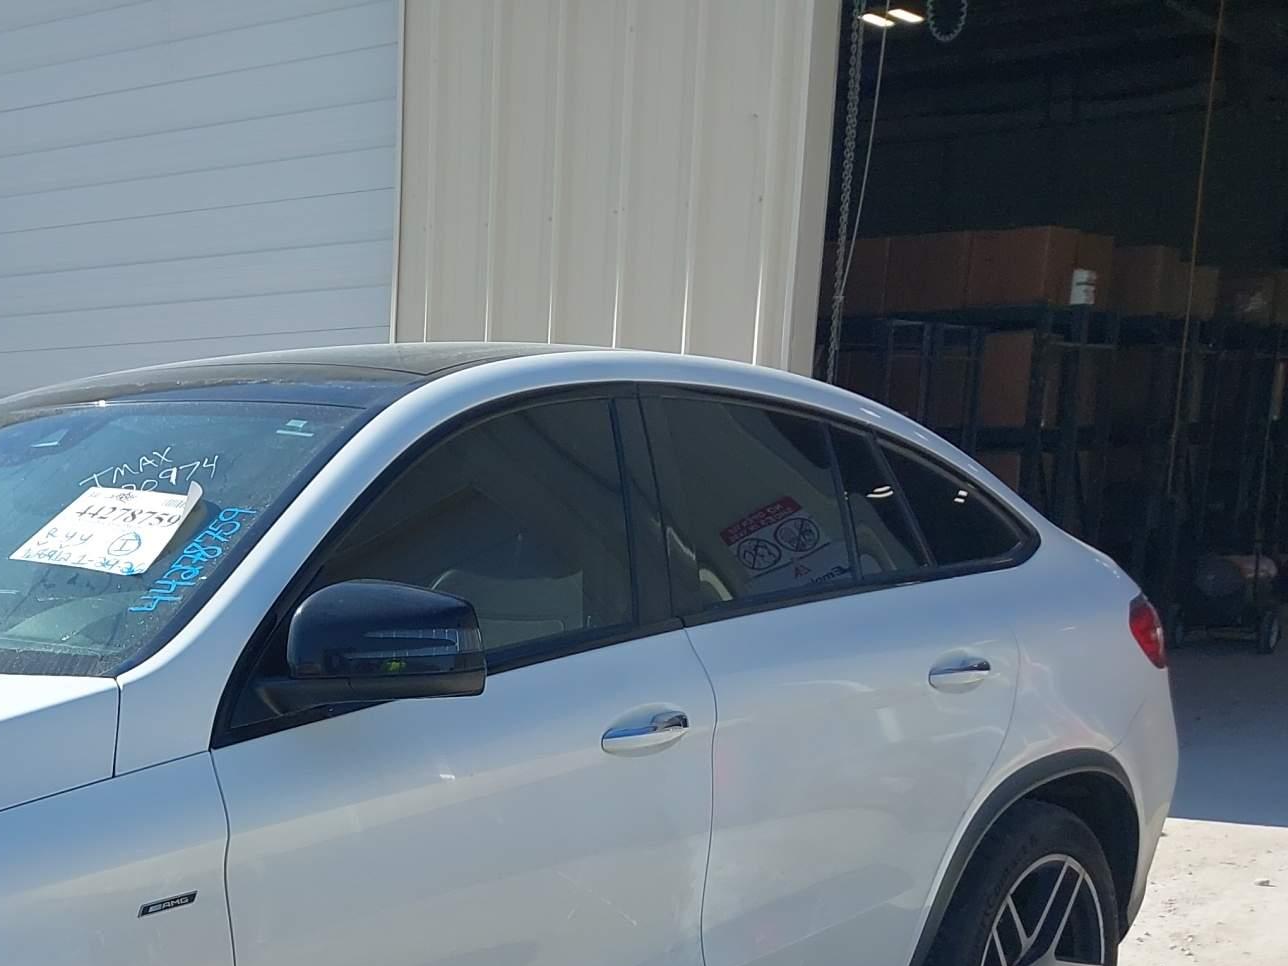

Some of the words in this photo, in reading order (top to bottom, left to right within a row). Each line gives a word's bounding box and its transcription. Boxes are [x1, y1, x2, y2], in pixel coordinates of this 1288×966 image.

[75, 504, 182, 528] 44278759
[128, 508, 257, 612] 44278759
[162, 896, 189, 909] AMG
